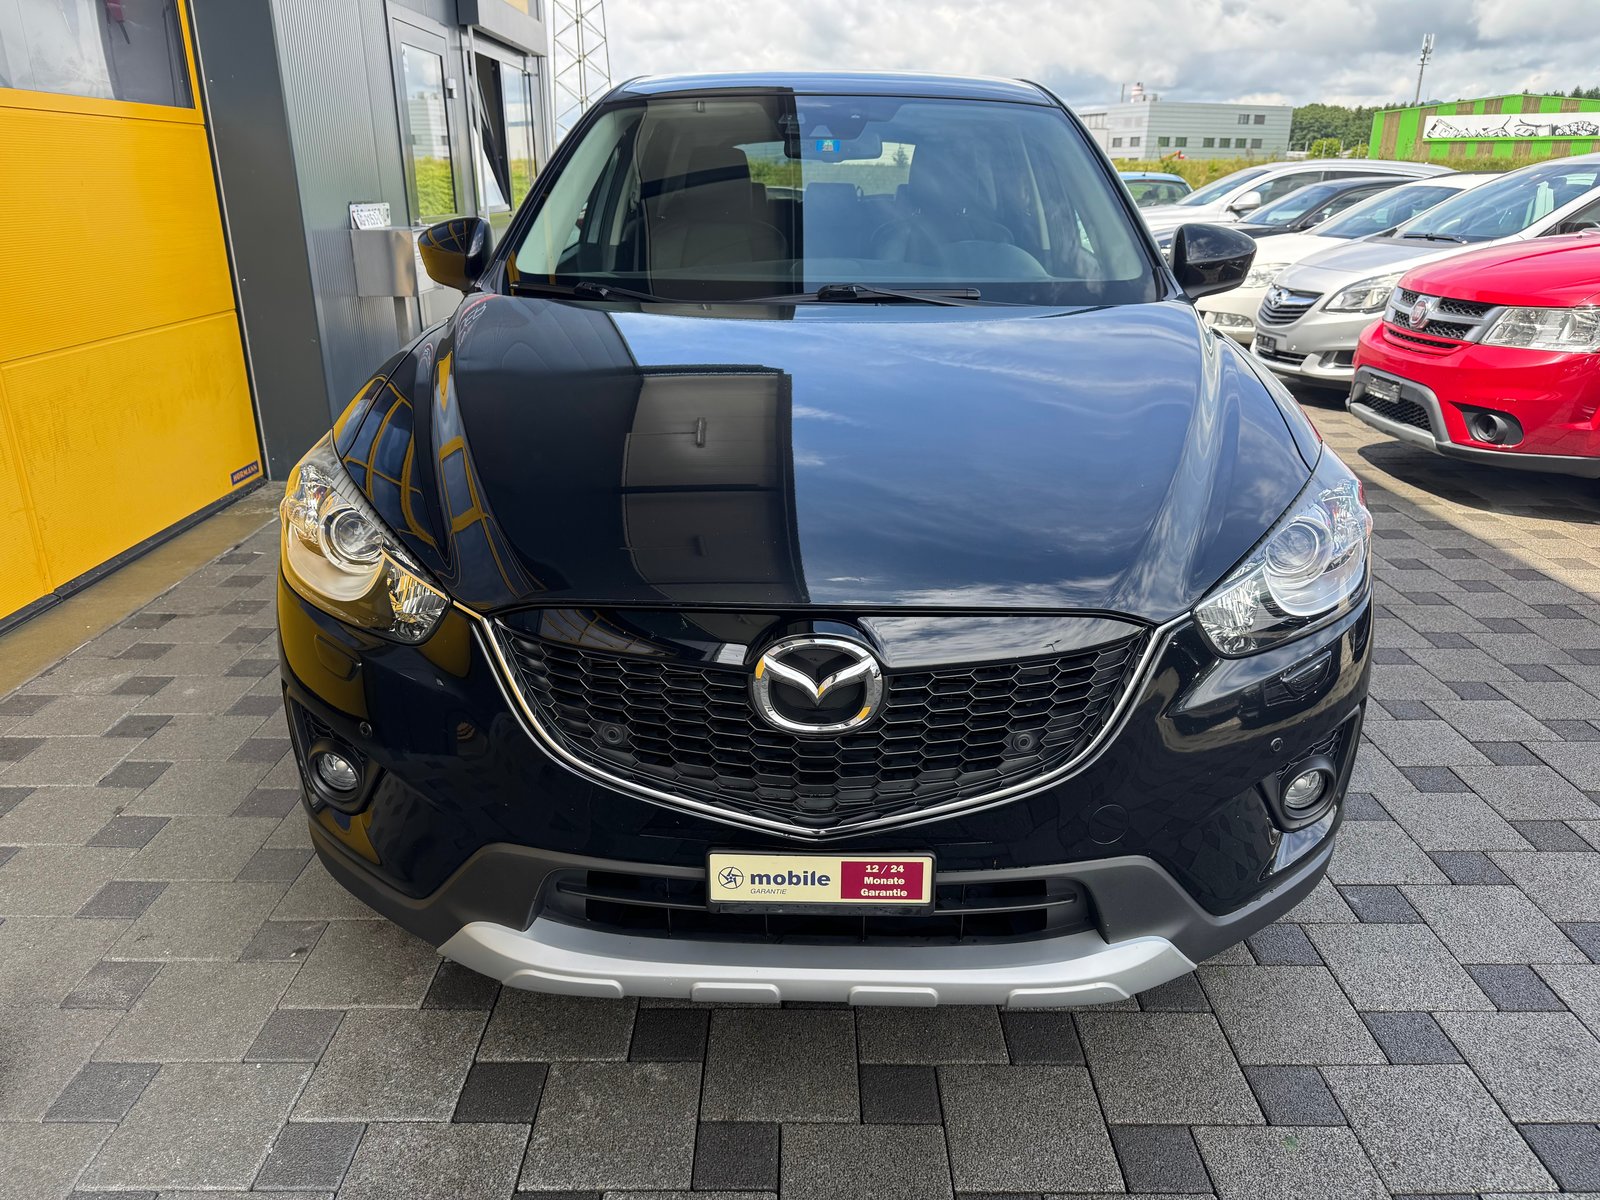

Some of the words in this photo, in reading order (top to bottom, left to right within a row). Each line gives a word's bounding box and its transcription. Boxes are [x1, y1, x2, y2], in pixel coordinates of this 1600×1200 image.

[865, 864, 879, 873] 12
[890, 864, 905, 873] 24
[750, 870, 831, 886] mobile
[863, 876, 905, 885] Monate
[860, 888, 908, 897] Garantie
